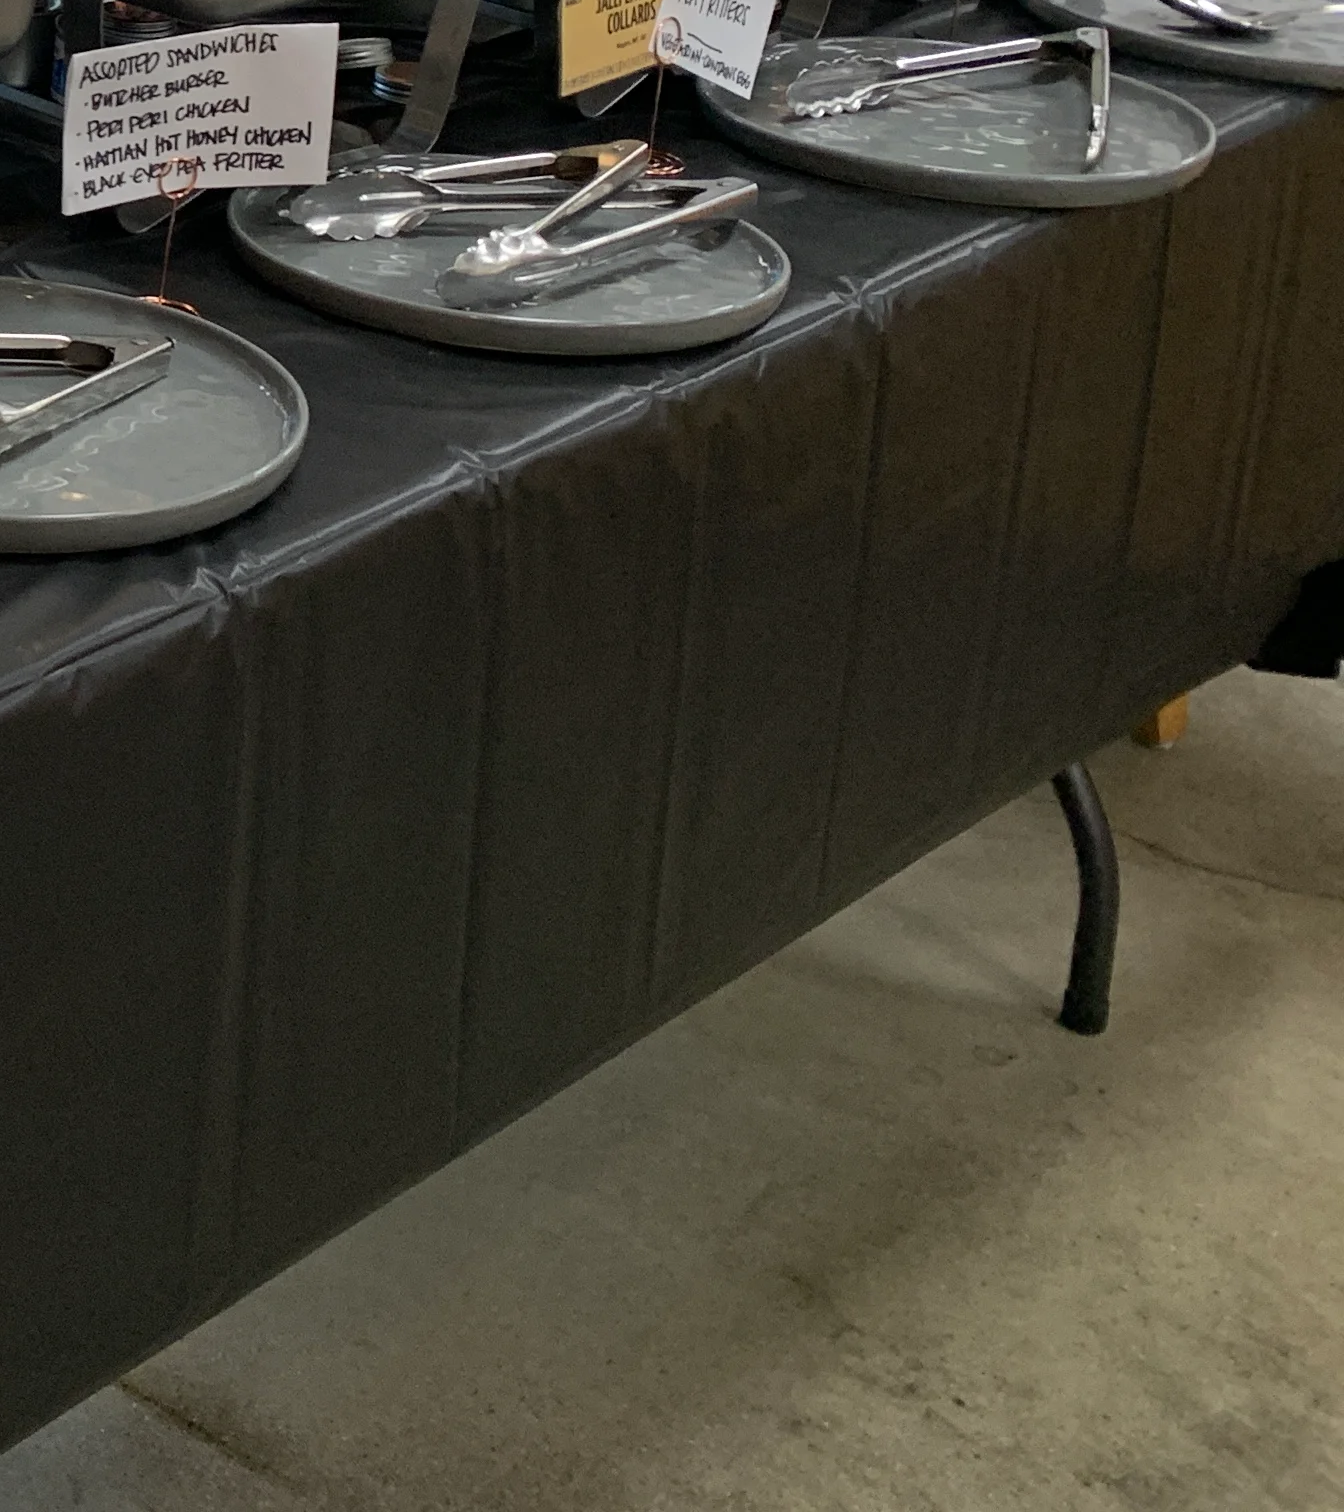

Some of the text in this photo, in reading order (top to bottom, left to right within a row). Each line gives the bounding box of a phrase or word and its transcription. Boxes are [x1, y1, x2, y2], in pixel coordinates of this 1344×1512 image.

[607, 0, 656, 35] COLLARDS
[79, 32, 279, 89] ASSORTED SANDWICHES
[91, 69, 229, 111] BUTCHER BURGER
[86, 95, 251, 142] PERI PERI CHICKEN
[155, 133, 182, 157] HOT
[186, 125, 239, 149] HONEY
[244, 121, 312, 147] CHICKEN
[176, 156, 206, 177] PEA
[213, 151, 285, 172] FRITTER
